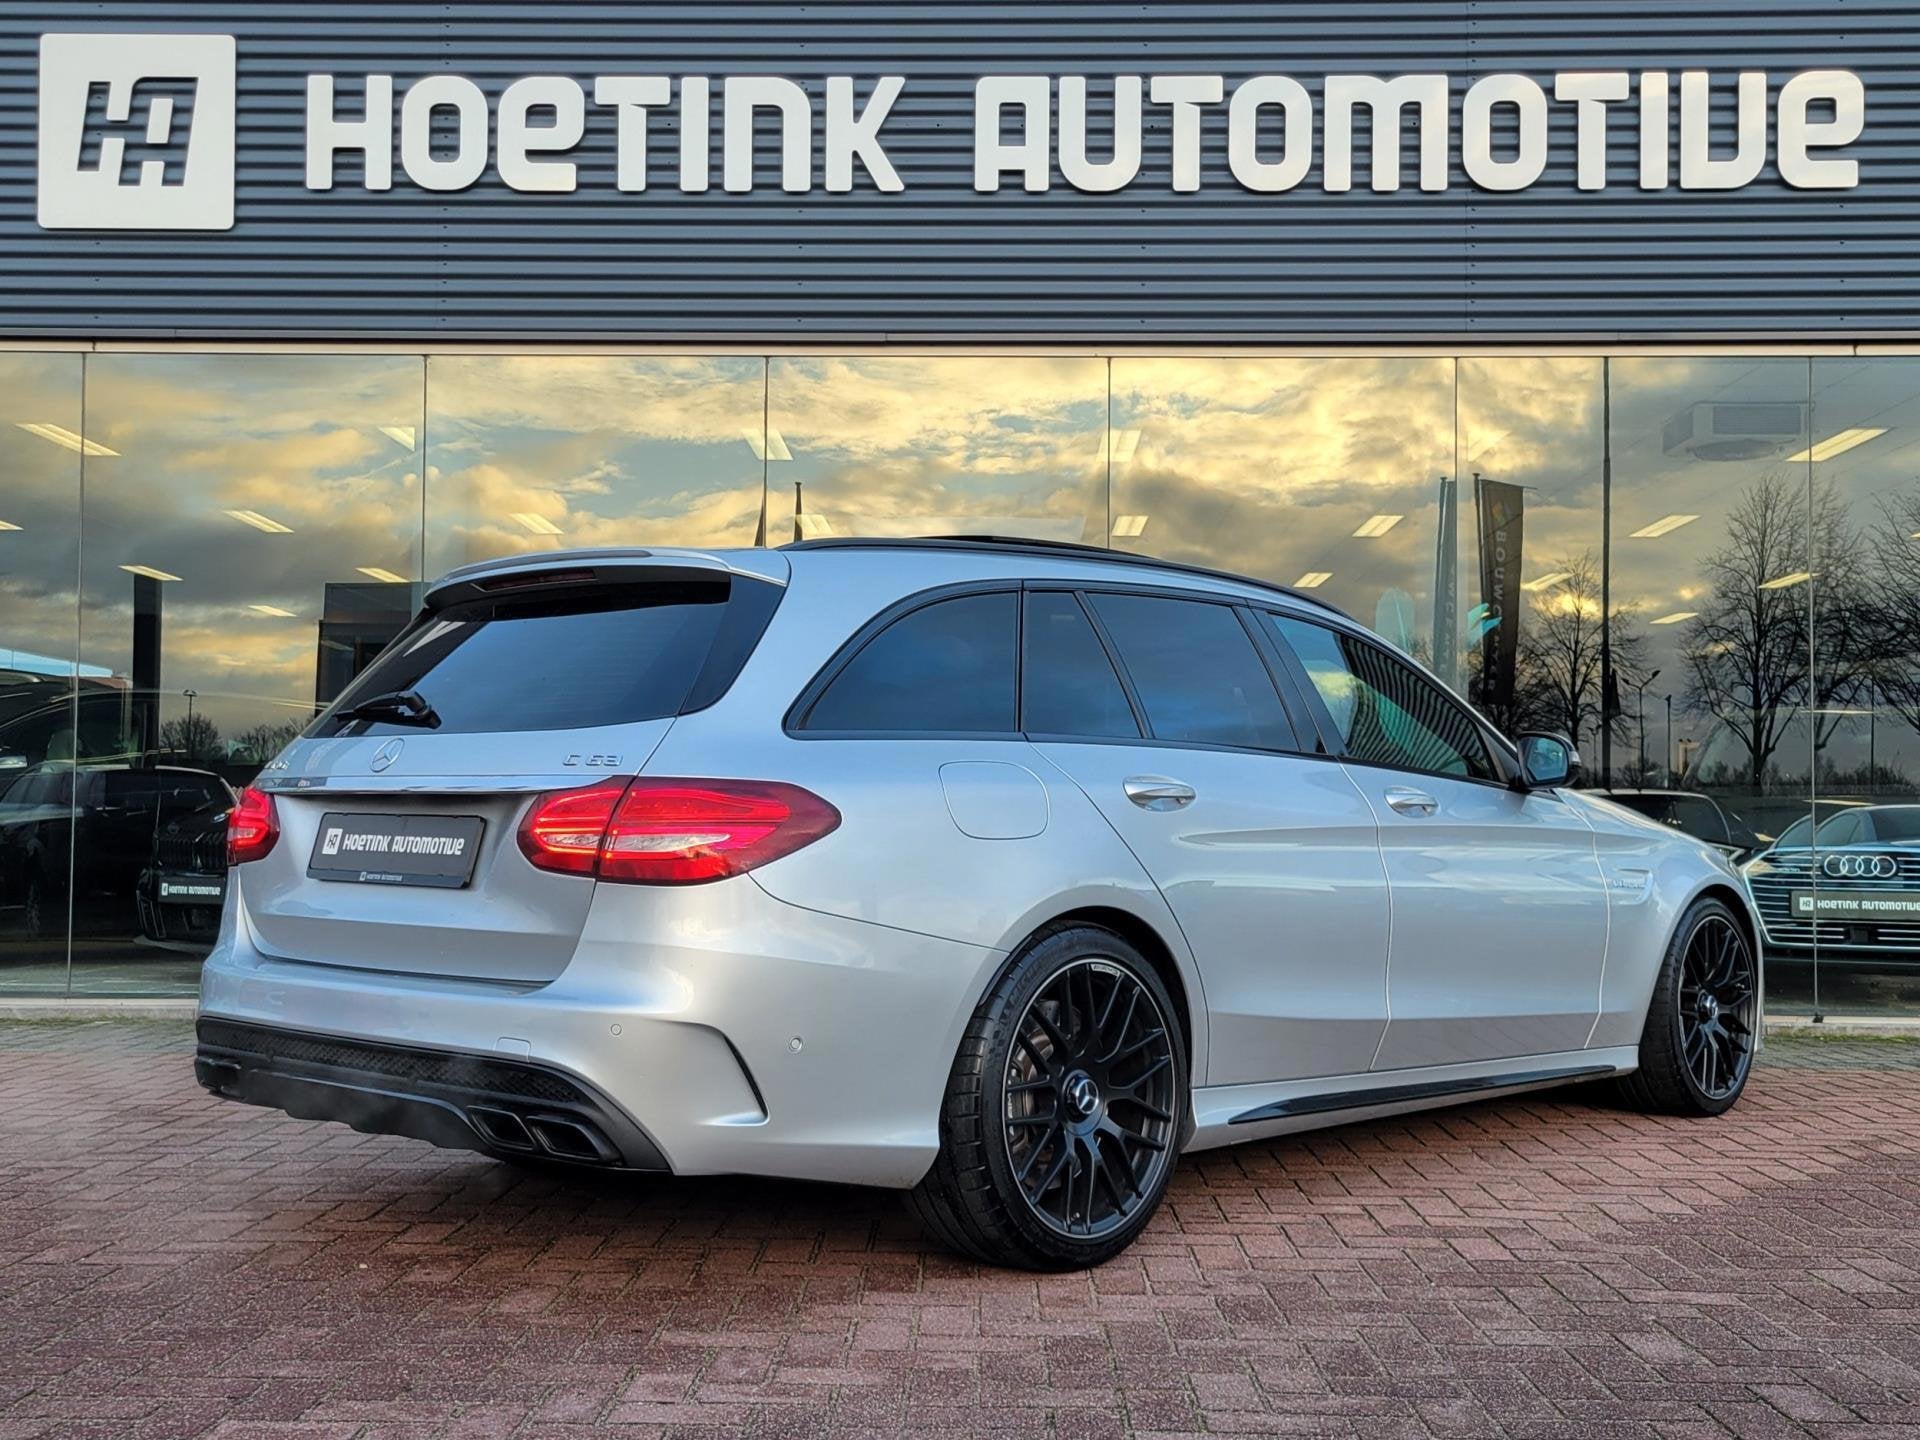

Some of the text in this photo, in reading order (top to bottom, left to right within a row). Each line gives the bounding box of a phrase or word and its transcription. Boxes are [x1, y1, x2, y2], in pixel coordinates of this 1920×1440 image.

[306, 70, 1865, 192] HOETINK AUTOMOTIVE
[563, 754, 623, 766] C 63
[342, 833, 465, 855] HOETINK AUTOMOTIVE
[1817, 900, 1859, 909] HOETINK
